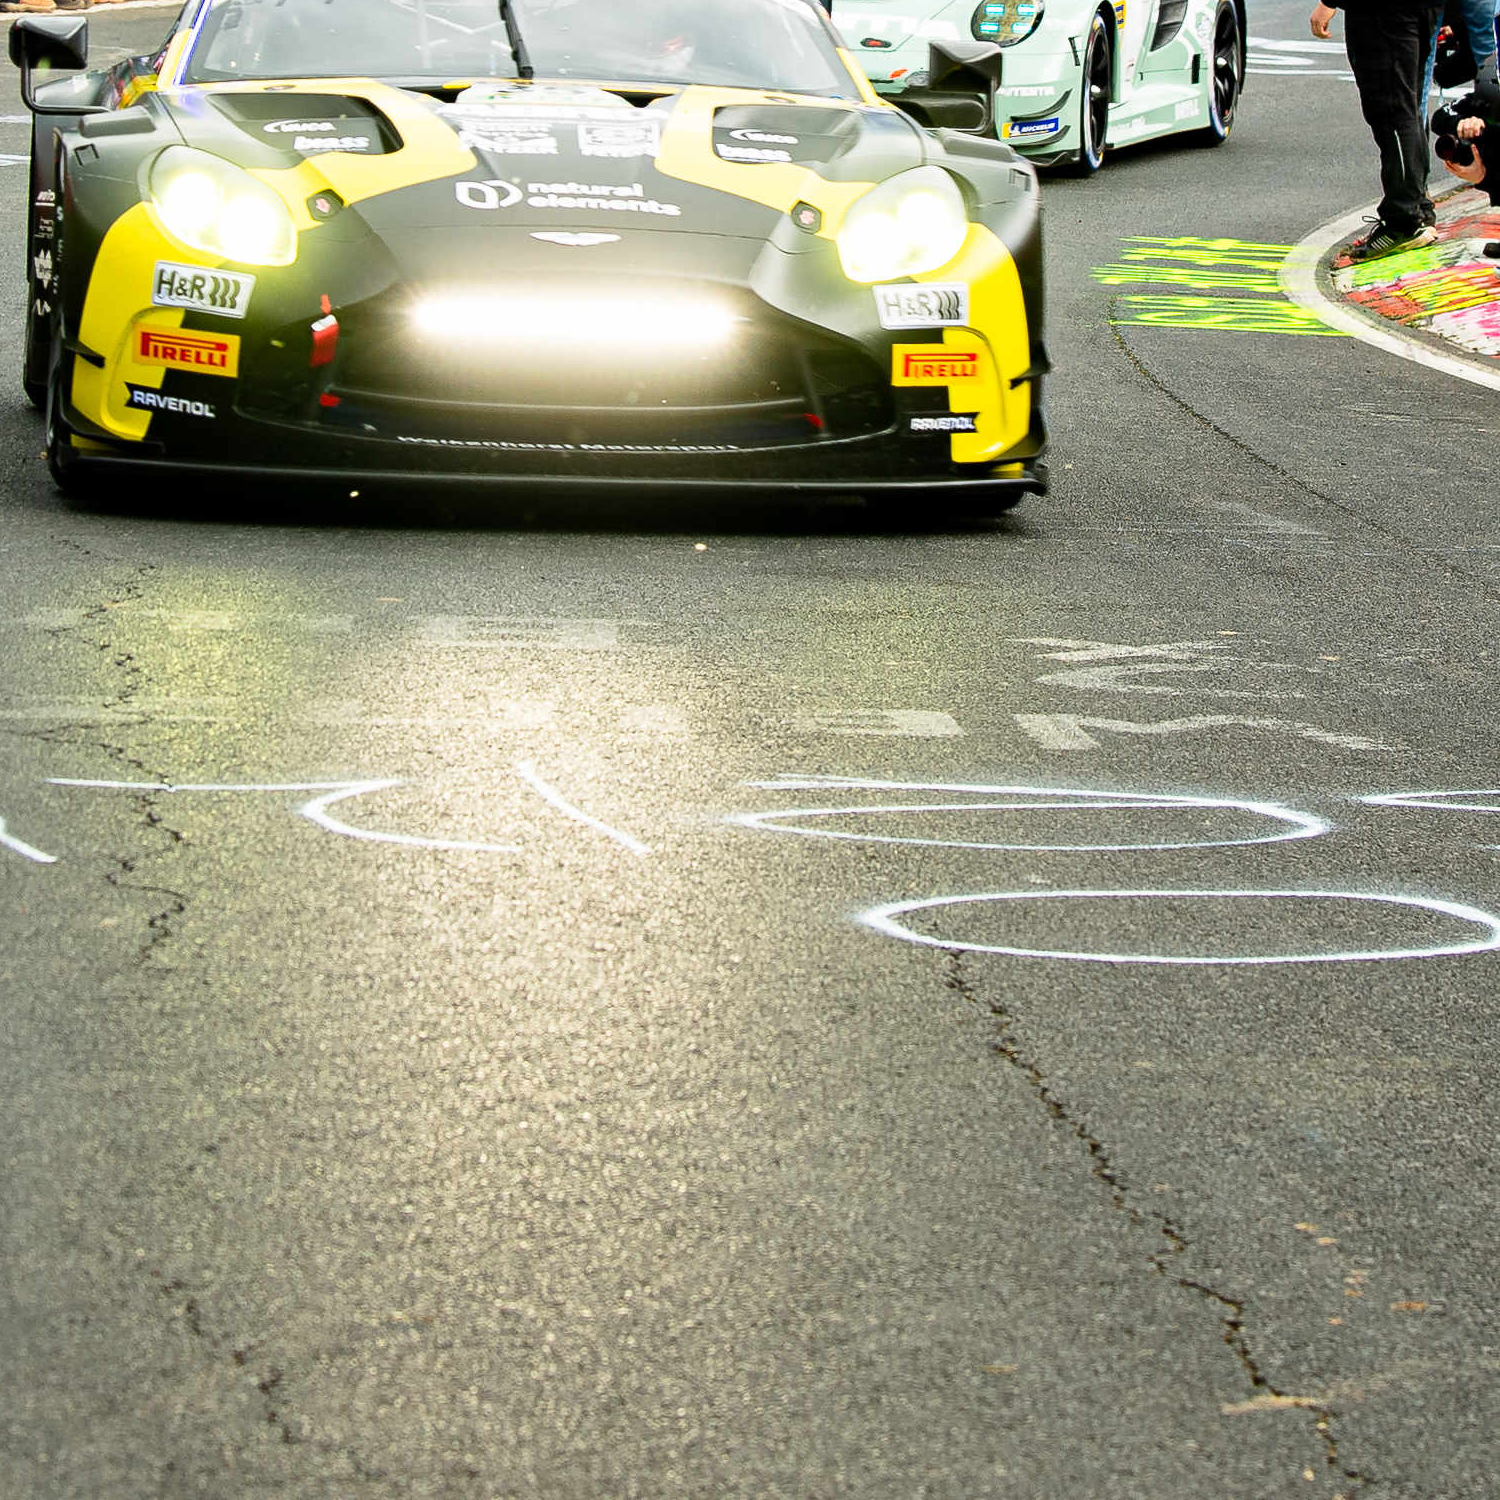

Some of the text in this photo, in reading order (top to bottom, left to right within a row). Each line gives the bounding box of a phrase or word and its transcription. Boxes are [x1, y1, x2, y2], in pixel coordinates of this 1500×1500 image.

[526, 180, 644, 199] natural
[526, 194, 683, 216] elements
[156, 269, 207, 302] H&R
[140, 331, 229, 368] PIRELLI
[903, 353, 978, 378] PIRELLI
[132, 389, 215, 418] RAVENOL
